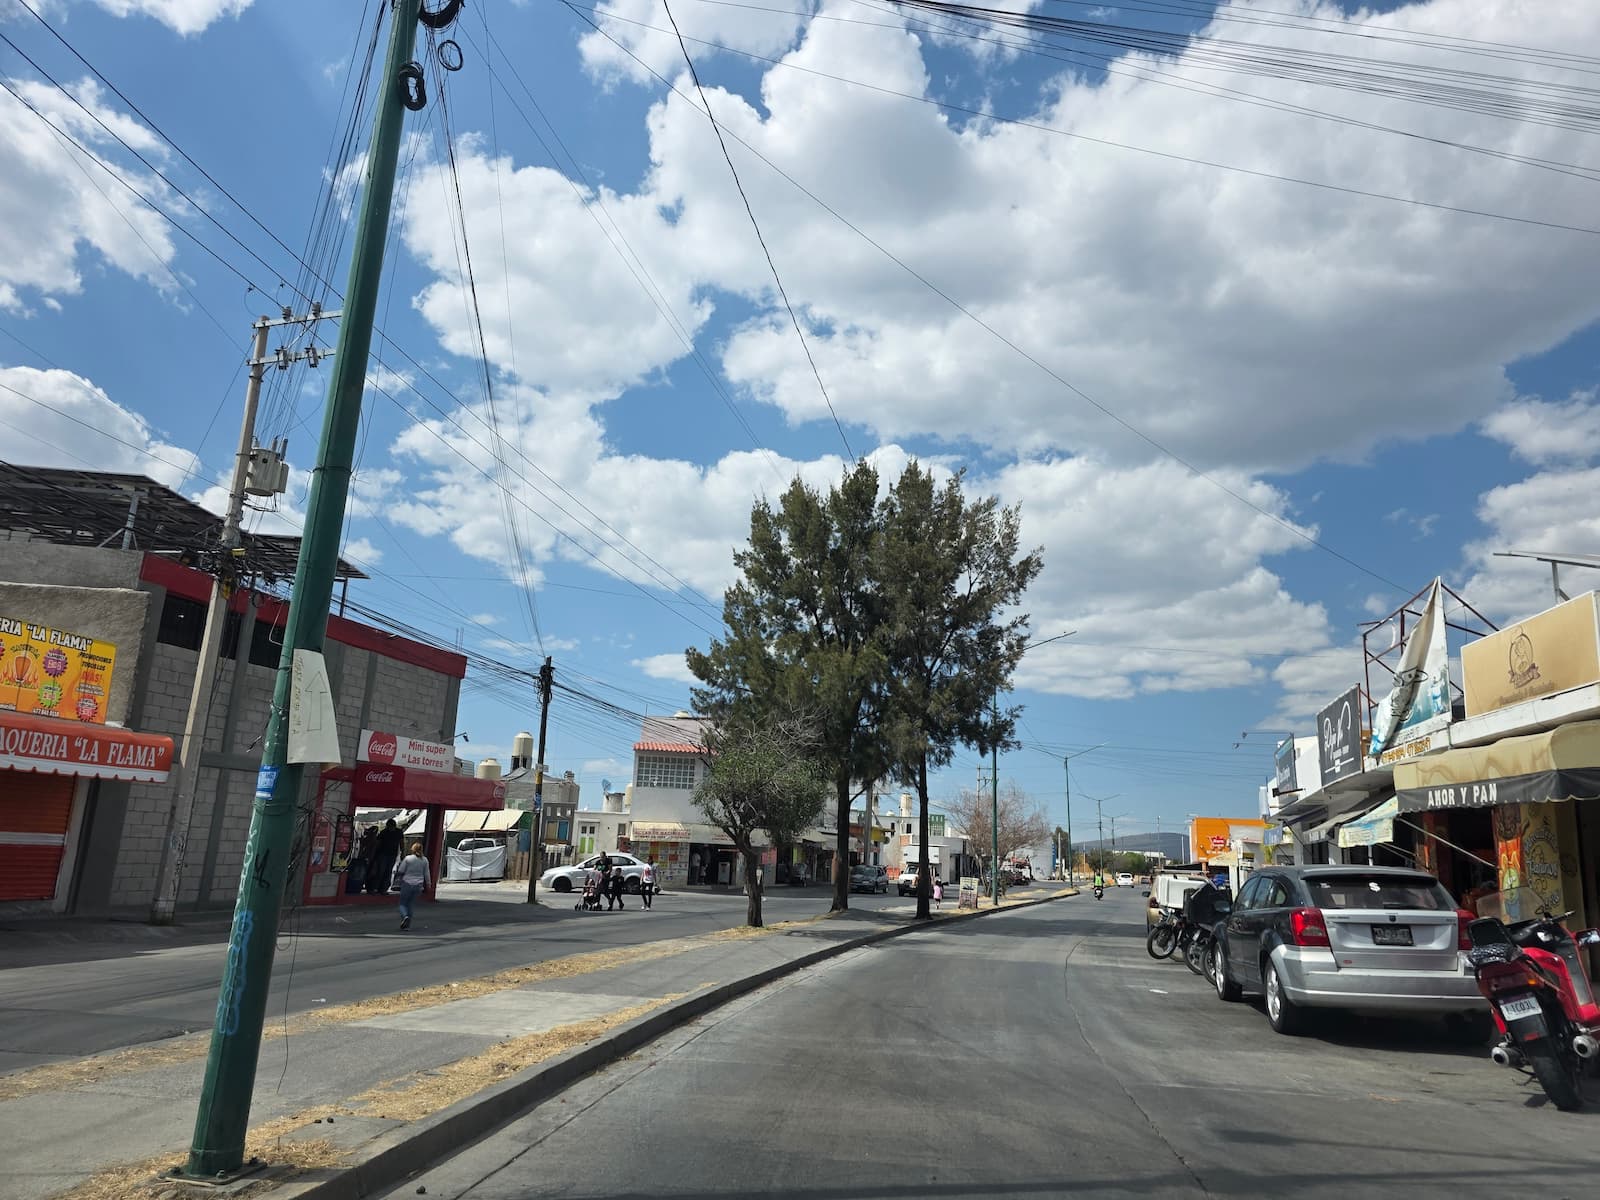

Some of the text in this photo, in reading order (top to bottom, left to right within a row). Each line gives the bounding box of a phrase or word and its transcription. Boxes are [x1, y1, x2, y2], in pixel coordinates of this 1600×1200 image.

[0, 617, 22, 636] RIA
[408, 741, 447, 755] Mini super
[1428, 783, 1497, 807] AMOR Y PAN
